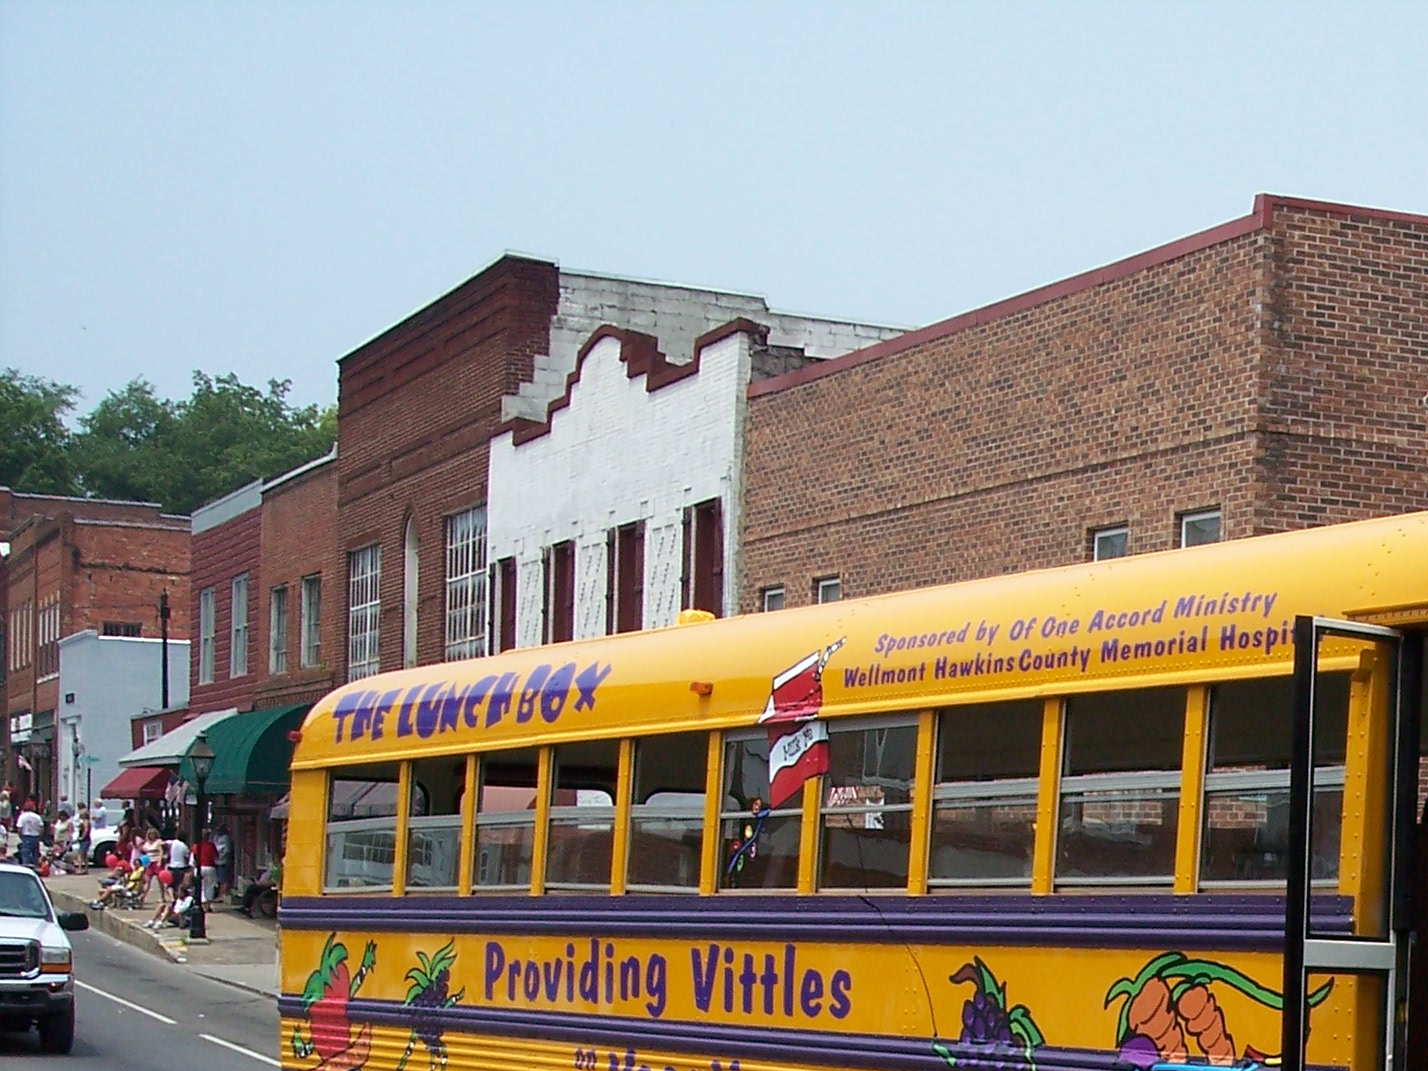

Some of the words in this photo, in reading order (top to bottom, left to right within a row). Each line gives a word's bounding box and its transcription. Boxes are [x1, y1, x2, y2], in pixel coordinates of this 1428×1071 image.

[844, 661, 926, 689] Wellmont
[934, 653, 1015, 680] Hawkins
[1018, 647, 1090, 673] County
[1100, 625, 1207, 664] Memorial
[874, 622, 970, 658] Sponsored
[975, 620, 1000, 646] by
[1009, 616, 1034, 642] Of
[1041, 615, 1080, 637] One
[1088, 599, 1167, 633] Accord
[1173, 590, 1278, 619] Ministry
[332, 689, 403, 744] THE
[397, 672, 520, 739] LUNCH
[516, 661, 612, 724] BOX
[484, 937, 668, 1018] Providing
[690, 942, 853, 1019] Vittles
[573, 1047, 598, 1071] on
